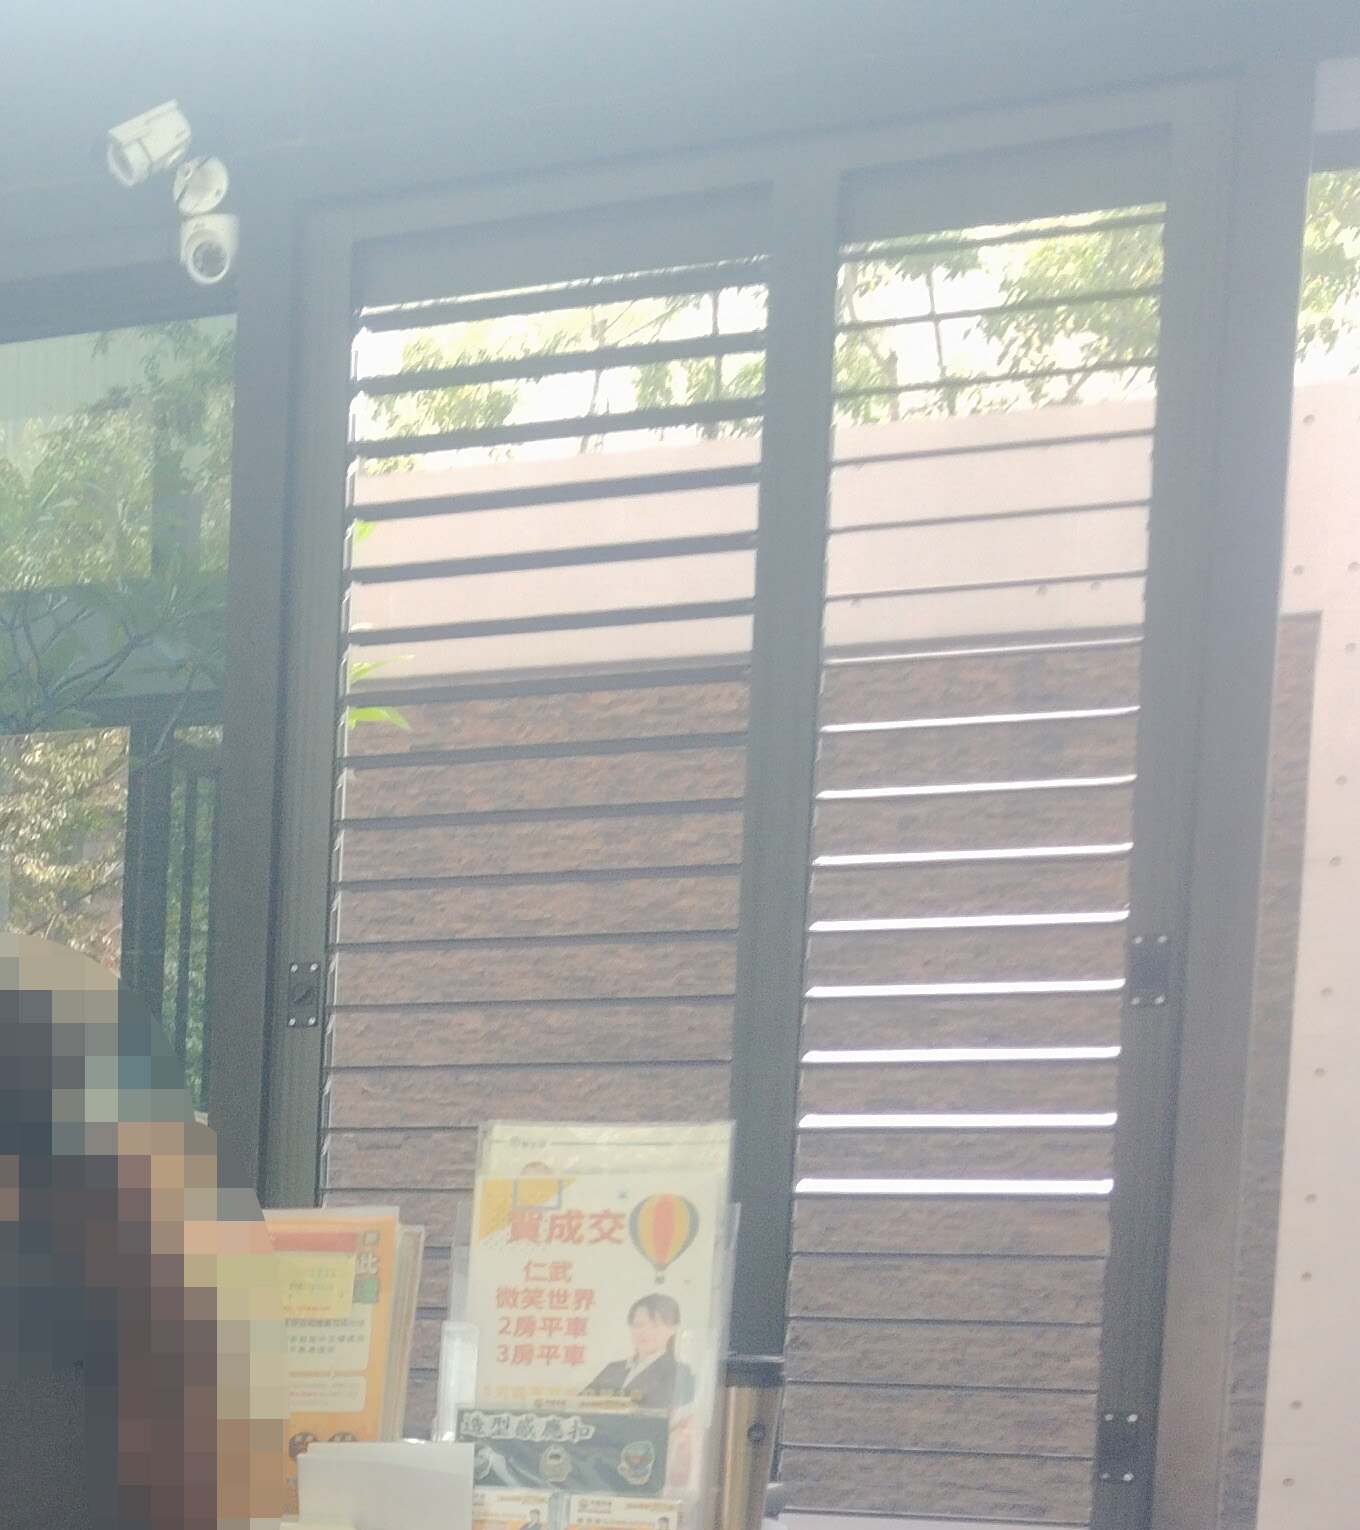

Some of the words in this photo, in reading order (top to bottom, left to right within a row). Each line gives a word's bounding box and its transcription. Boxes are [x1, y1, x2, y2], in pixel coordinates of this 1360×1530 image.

[506, 1208, 627, 1246] 賀成交
[522, 1259, 573, 1283] 仁武
[495, 1285, 596, 1311] 微笑世界
[497, 1315, 589, 1339] 2房平車
[495, 1342, 586, 1367] 3房平車
